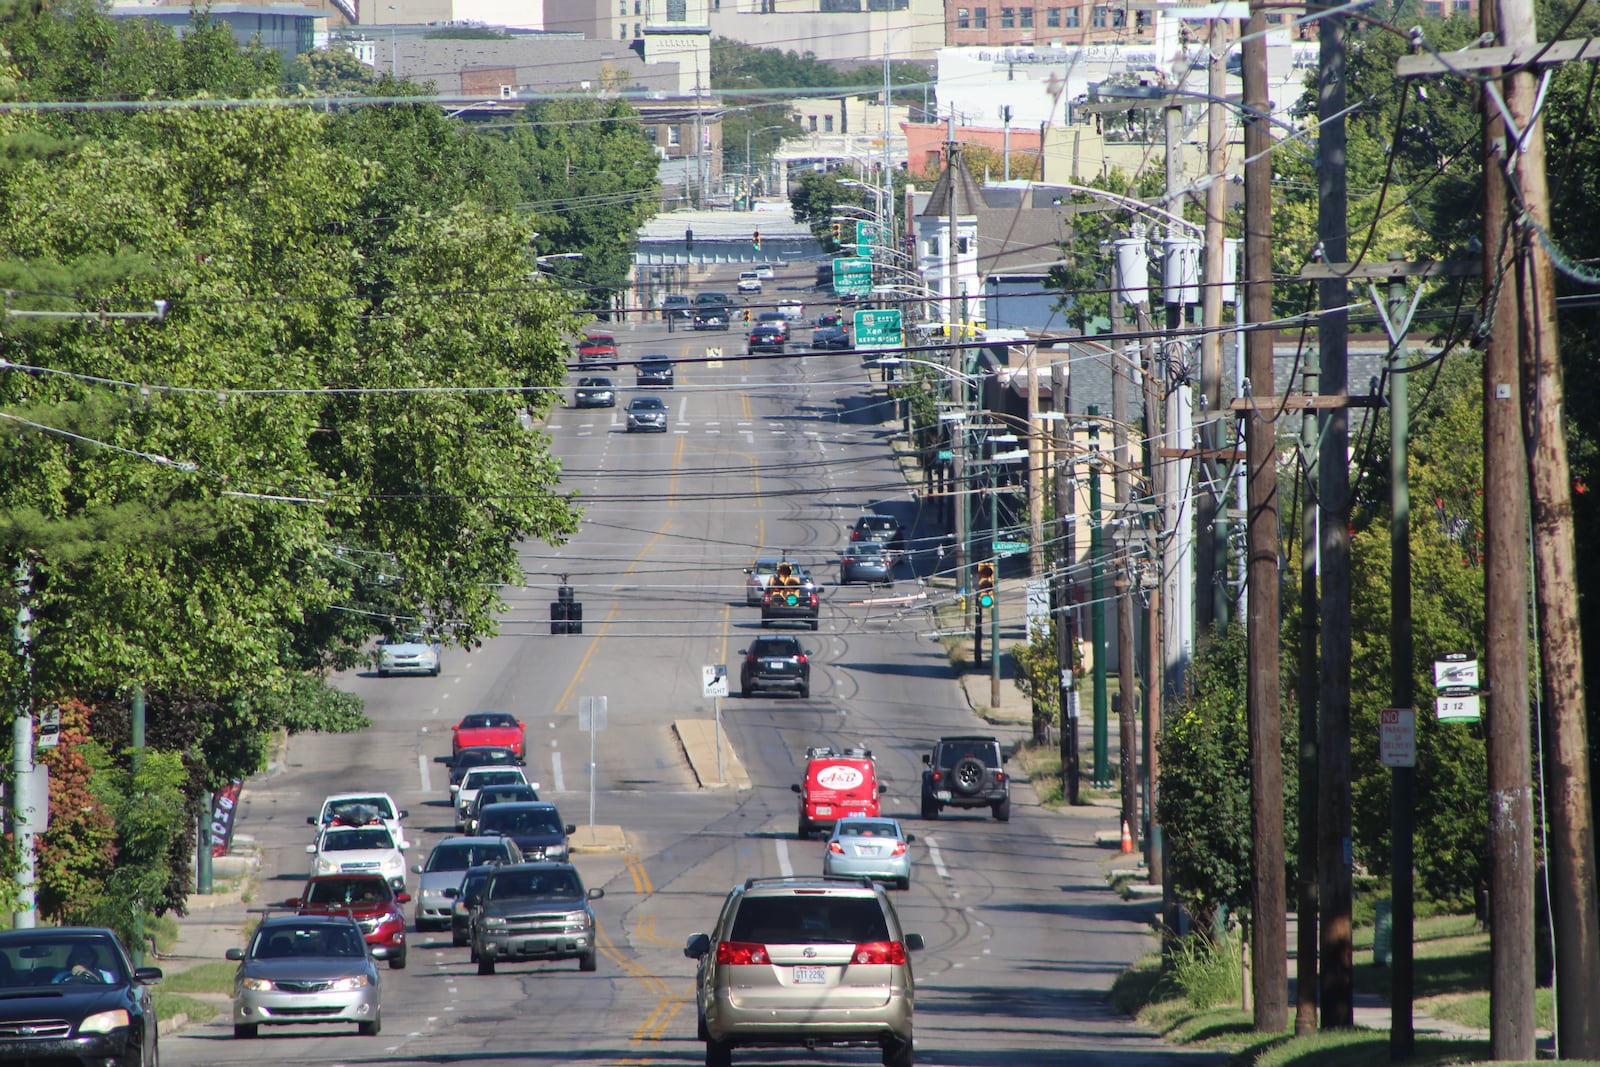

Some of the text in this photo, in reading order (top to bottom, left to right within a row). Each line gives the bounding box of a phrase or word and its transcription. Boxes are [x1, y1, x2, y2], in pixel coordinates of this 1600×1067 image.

[1442, 702, 1464, 711] 3 12
[1383, 711, 1398, 722] NO
